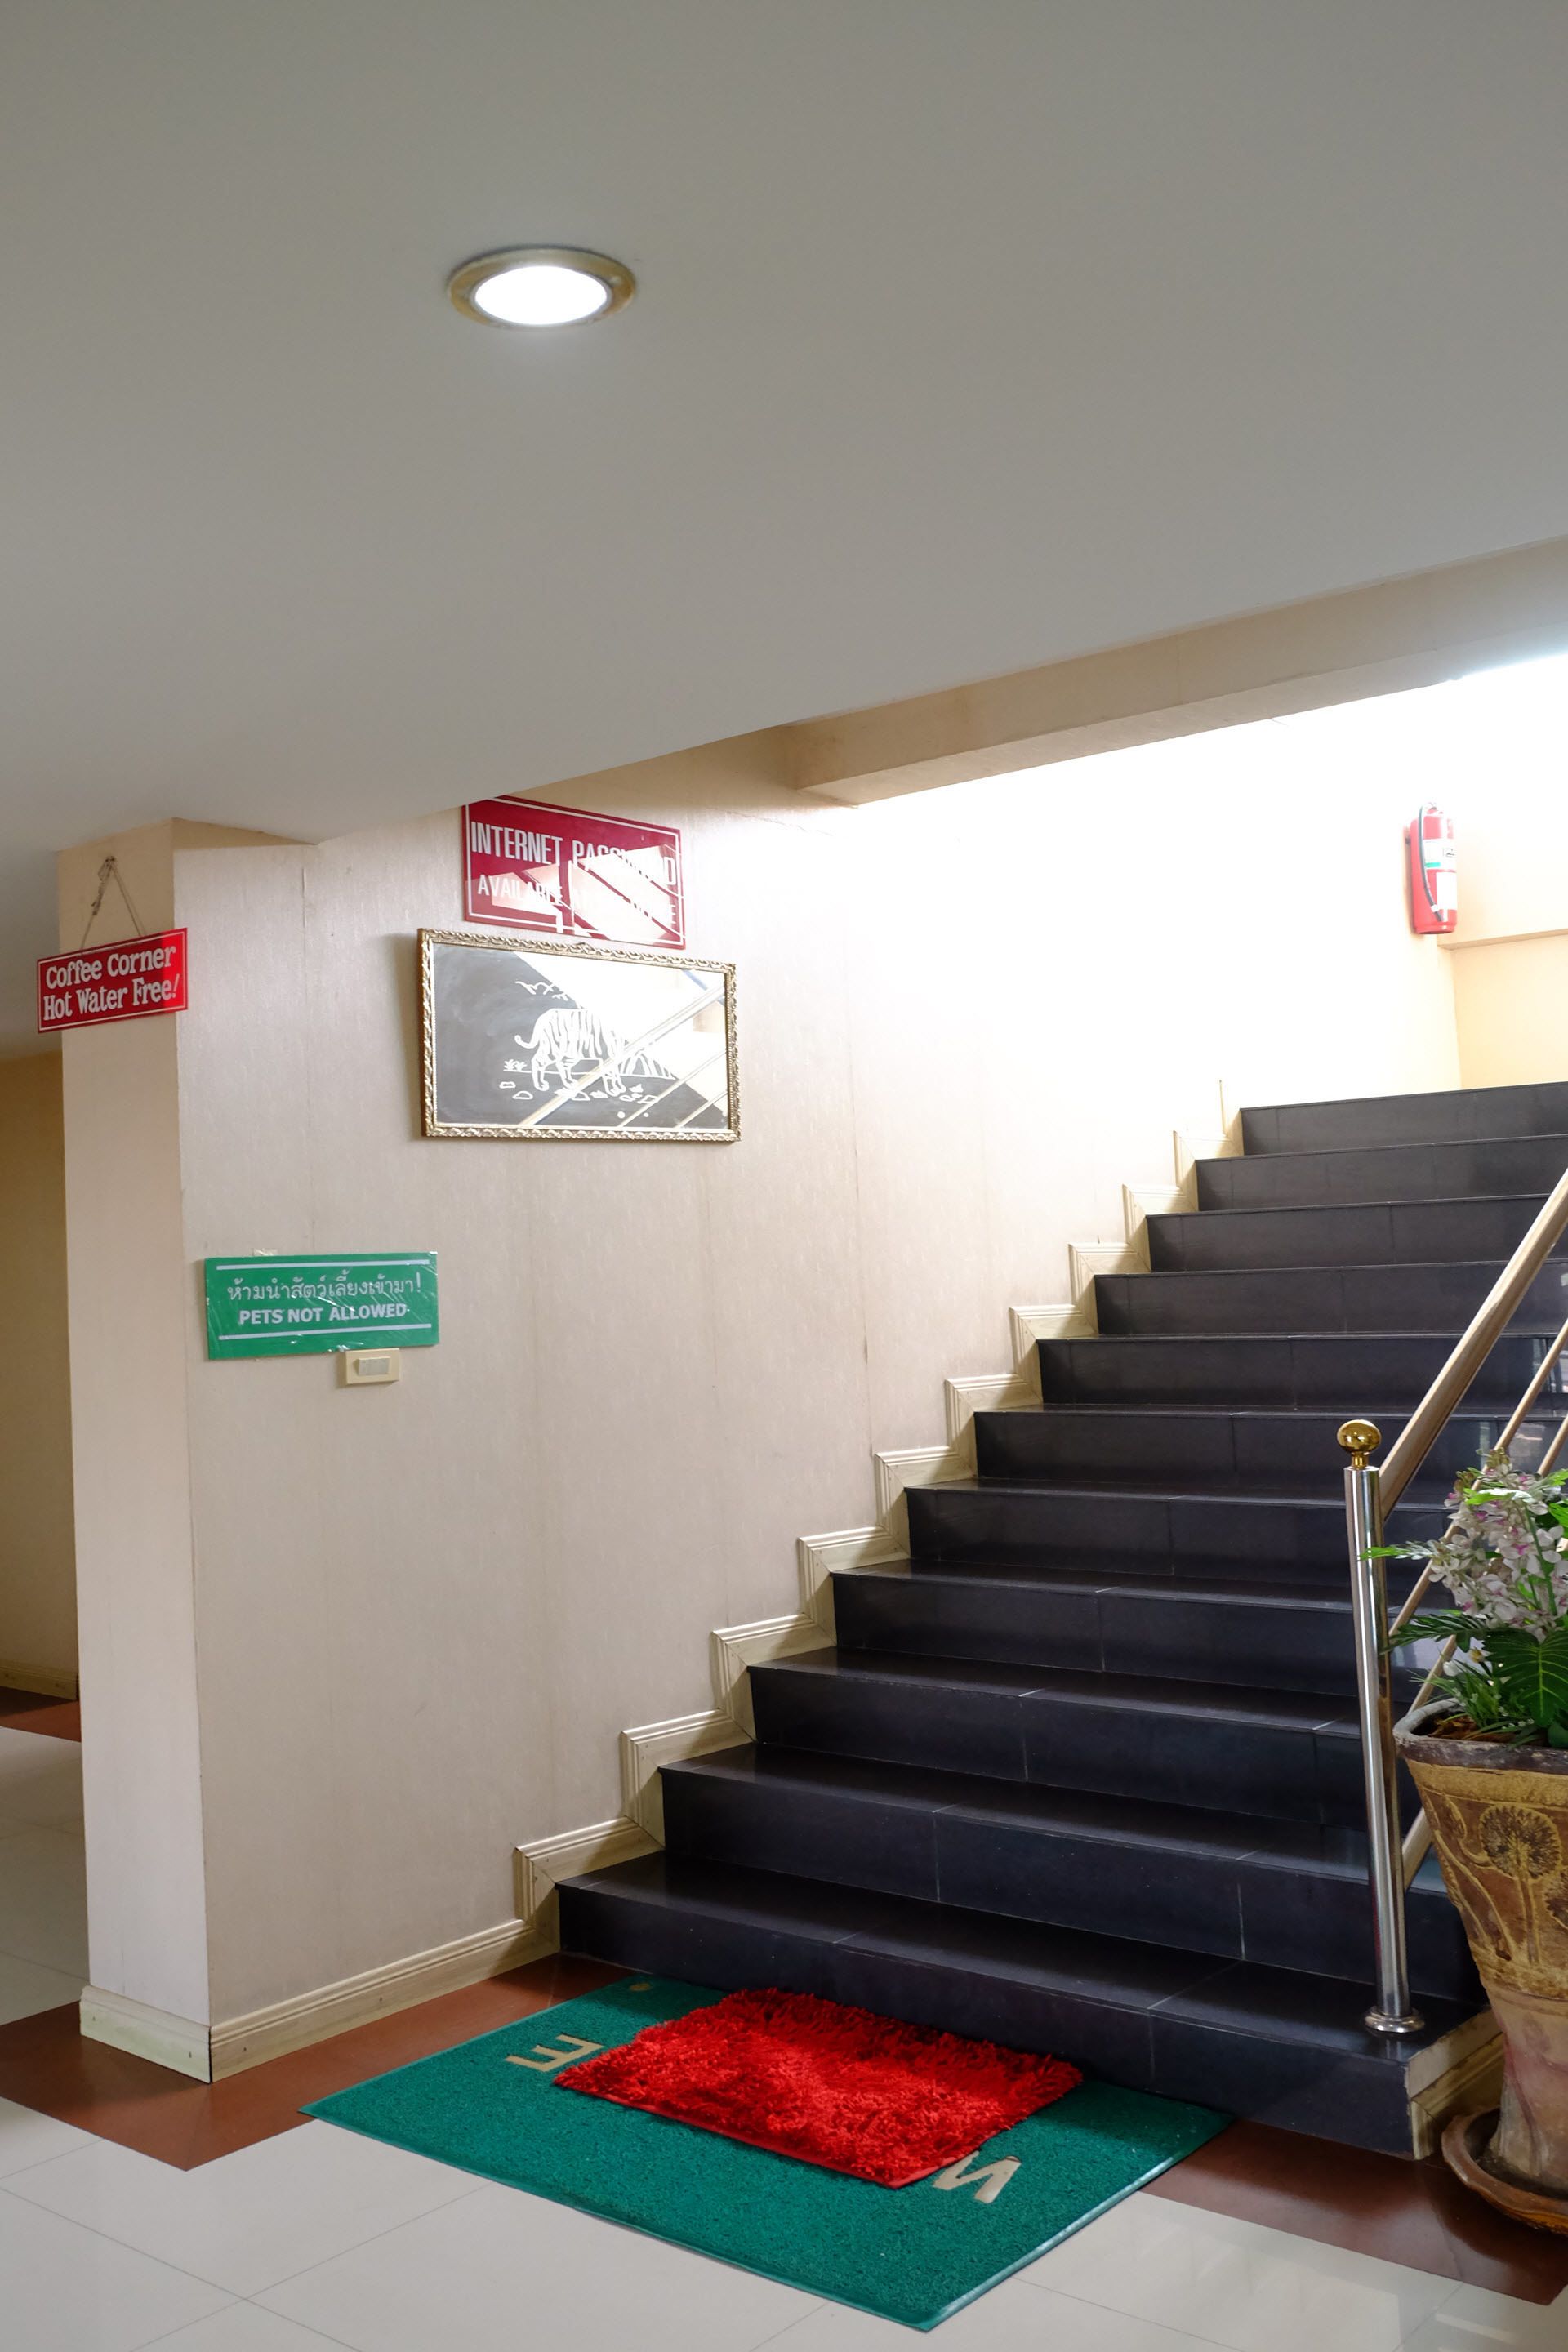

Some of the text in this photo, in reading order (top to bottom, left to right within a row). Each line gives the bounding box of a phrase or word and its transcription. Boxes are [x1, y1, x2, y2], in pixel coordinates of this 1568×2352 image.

[470, 822, 563, 866] INTERNET
[46, 945, 176, 989] Coffee Corner
[43, 973, 180, 1021] Hot Water Free!
[238, 1303, 408, 1325] PETS NOT ALLOWED
